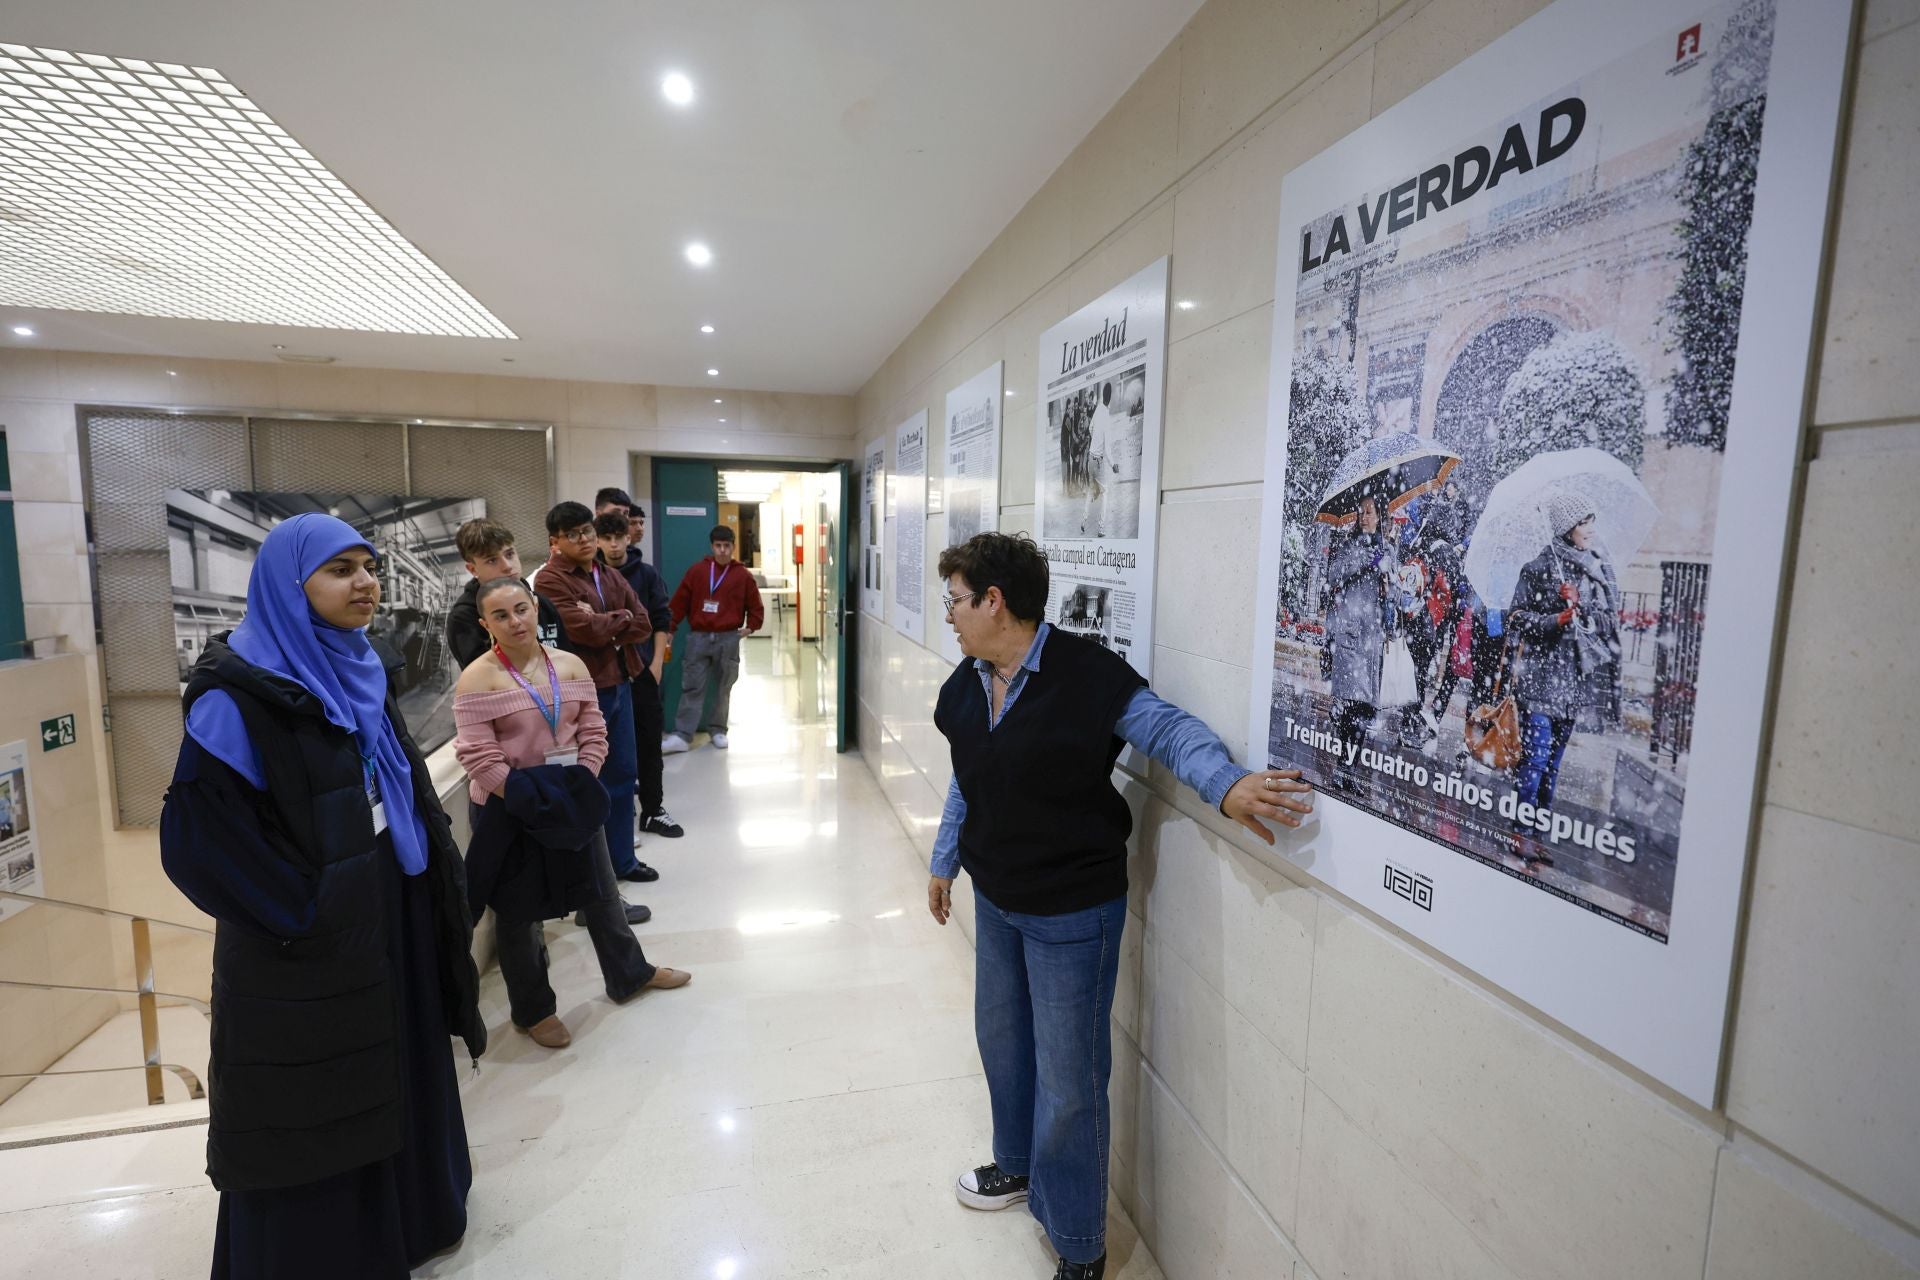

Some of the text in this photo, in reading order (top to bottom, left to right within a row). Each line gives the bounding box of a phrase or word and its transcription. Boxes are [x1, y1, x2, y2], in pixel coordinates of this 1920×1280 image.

[1302, 97, 1587, 273] LA VERDAD
[1061, 341, 1077, 374] La
[1080, 306, 1128, 365] verdad
[1062, 545, 1085, 570] campal
[1087, 551, 1095, 566] en
[1097, 545, 1136, 575] Cartagena
[1285, 717, 1636, 863] Treinta y cuatro años después
[1362, 780, 1385, 794] ESPECIAL
[1385, 789, 1394, 797] DE
[1407, 799, 1430, 812] NEVADA
[1431, 808, 1465, 825] HISTÓRICA
[1494, 831, 1521, 849] ÚLTIMA
[1405, 824, 1419, 834] donde
[1455, 846, 1465, 855] una
[1465, 850, 1484, 863] imagen
[1484, 858, 1502, 870] similar
[1502, 866, 1519, 879] desde
[1526, 876, 1533, 885] 12
[1533, 880, 1541, 888] de
[1542, 883, 1566, 899] febrero
[1566, 894, 1575, 903] de
[1600, 910, 1624, 925] VICENTE
[1624, 921, 1647, 935] VICENS
